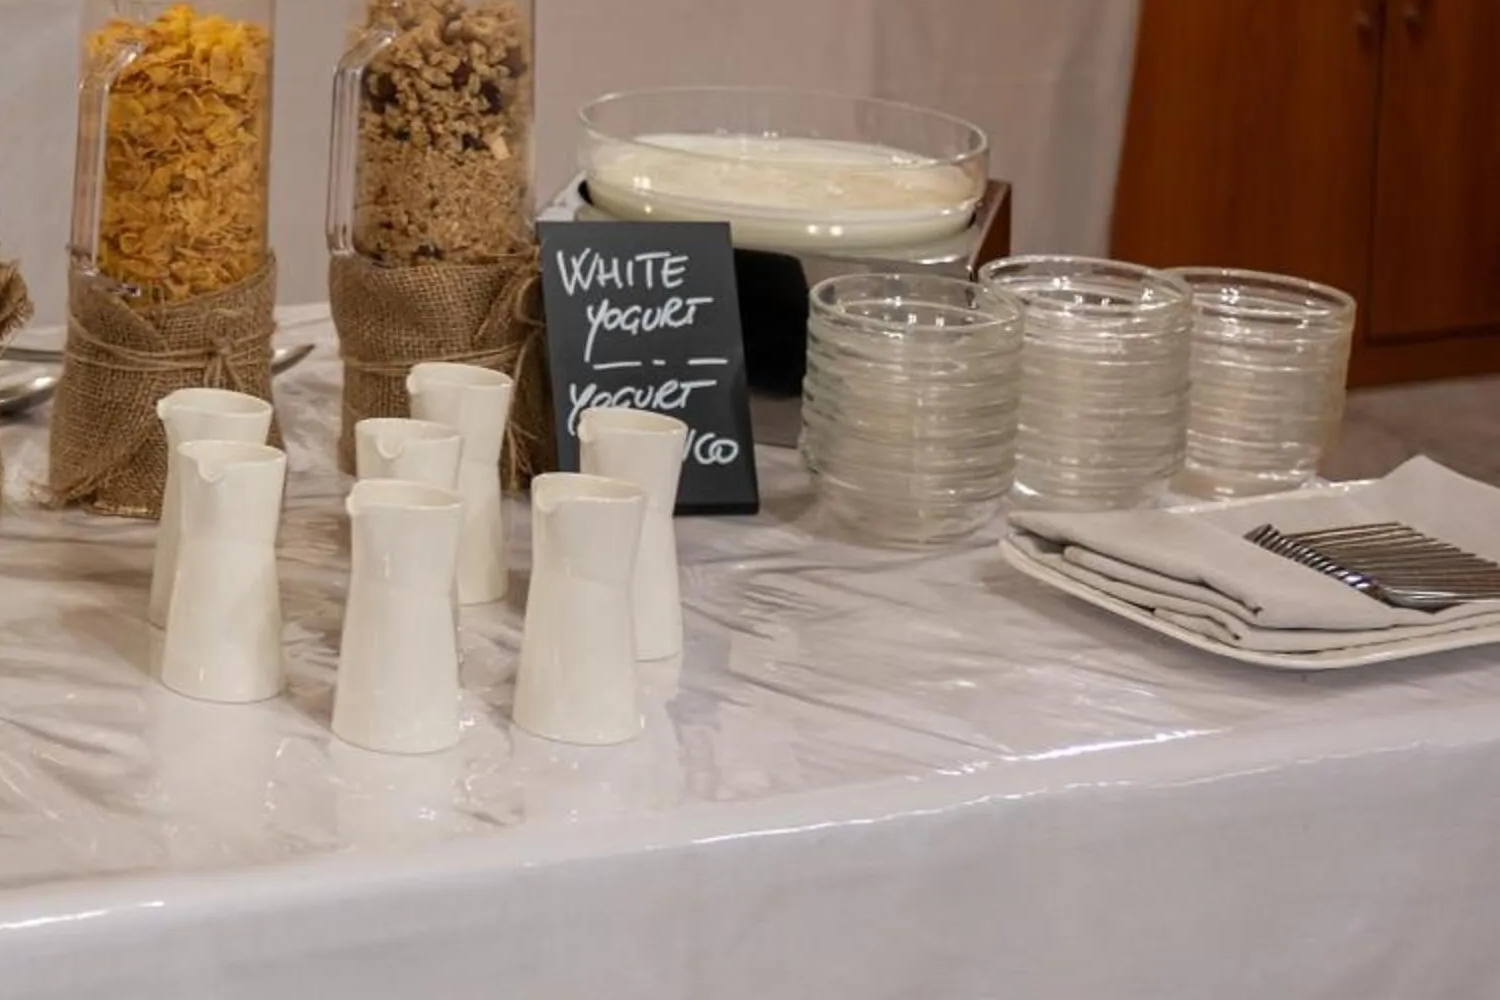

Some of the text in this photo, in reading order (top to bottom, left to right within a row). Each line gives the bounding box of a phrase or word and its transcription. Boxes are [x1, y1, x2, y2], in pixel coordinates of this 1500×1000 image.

[556, 247, 689, 296] WHITE
[583, 296, 714, 363] YOGURT
[567, 379, 718, 436] YOGURT
